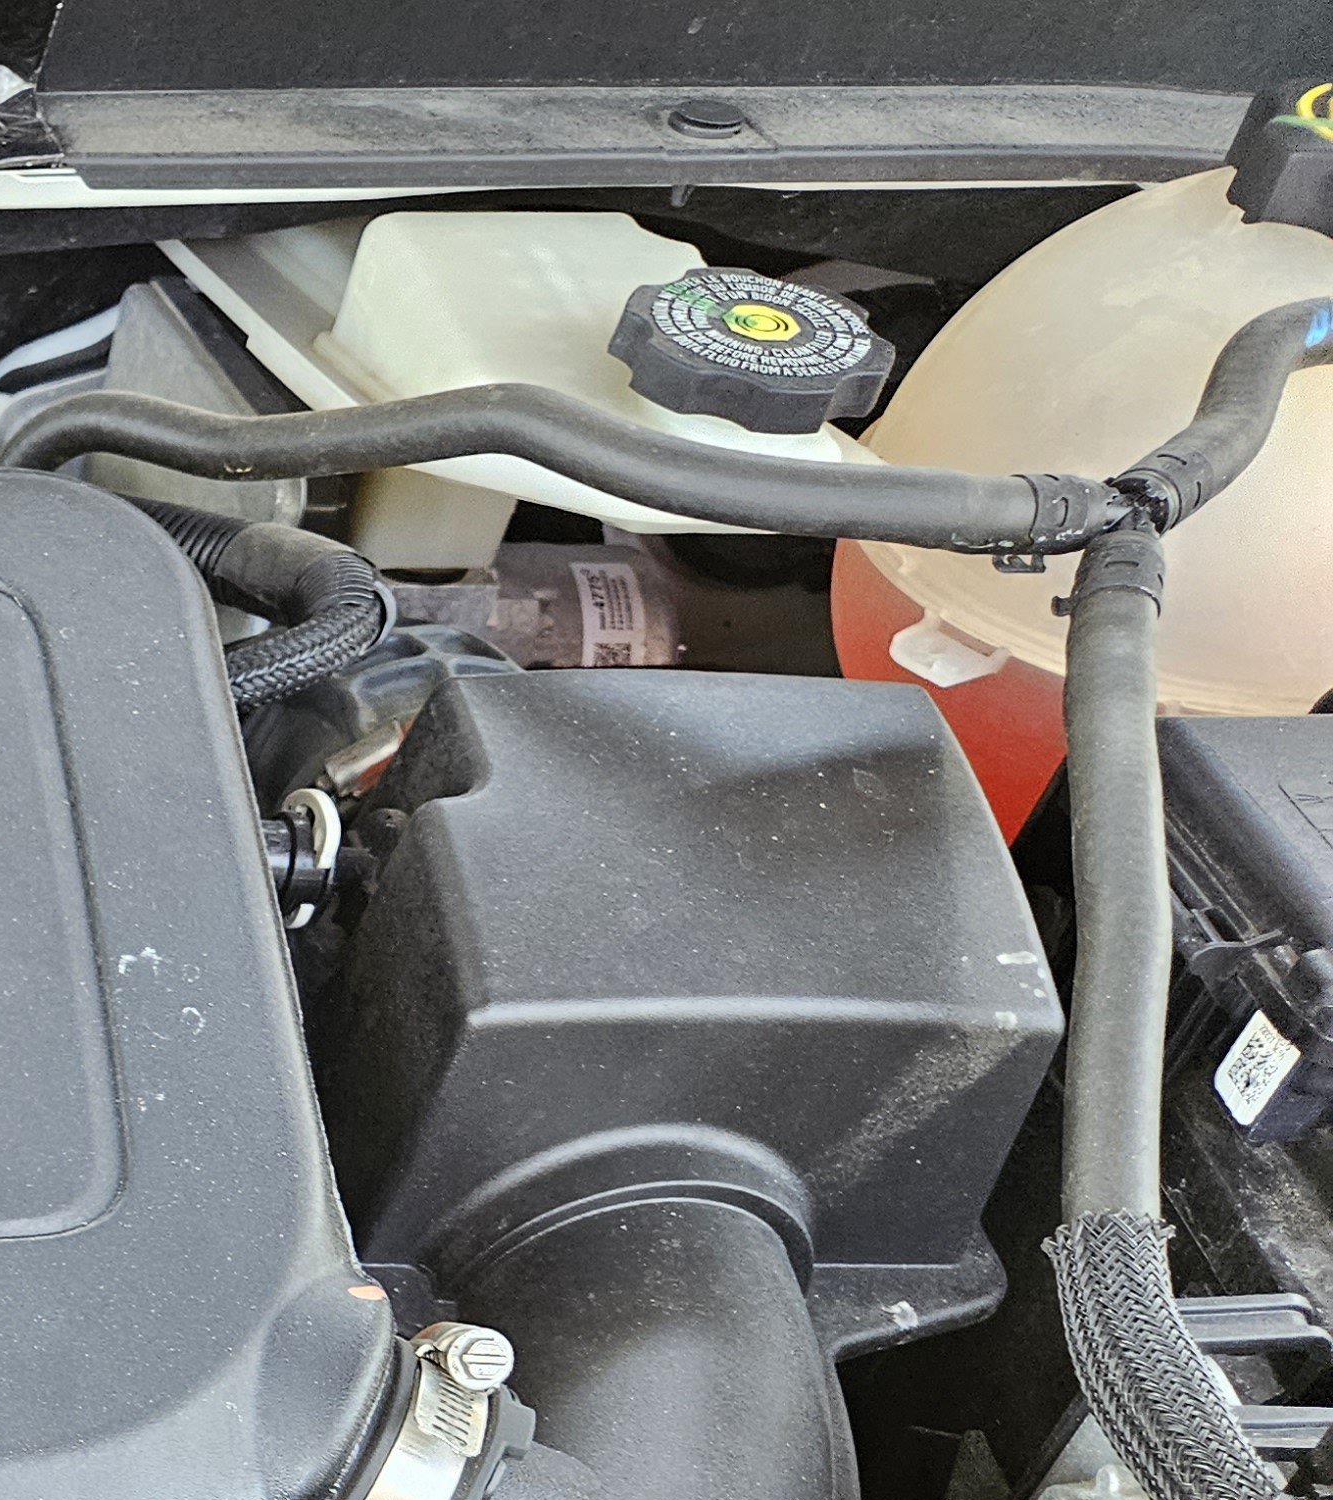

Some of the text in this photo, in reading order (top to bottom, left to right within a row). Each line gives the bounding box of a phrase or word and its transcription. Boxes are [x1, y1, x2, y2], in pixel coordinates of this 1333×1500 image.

[702, 275, 720, 284] LE
[721, 273, 783, 288] BOUCHON
[783, 282, 827, 301] AVANT
[707, 282, 728, 293] DU
[730, 281, 779, 296] LIQUIDE
[779, 290, 799, 301] DE
[751, 292, 792, 307] BIDON
[704, 330, 769, 356] WARNING:
[772, 346, 815, 357] CLEAN
[707, 342, 759, 364] BEFORE
[821, 346, 846, 361] USE
[700, 349, 742, 368] FLUID
[741, 361, 781, 376] FROM
[783, 365, 795, 377] A
[792, 362, 841, 377] SEALED
